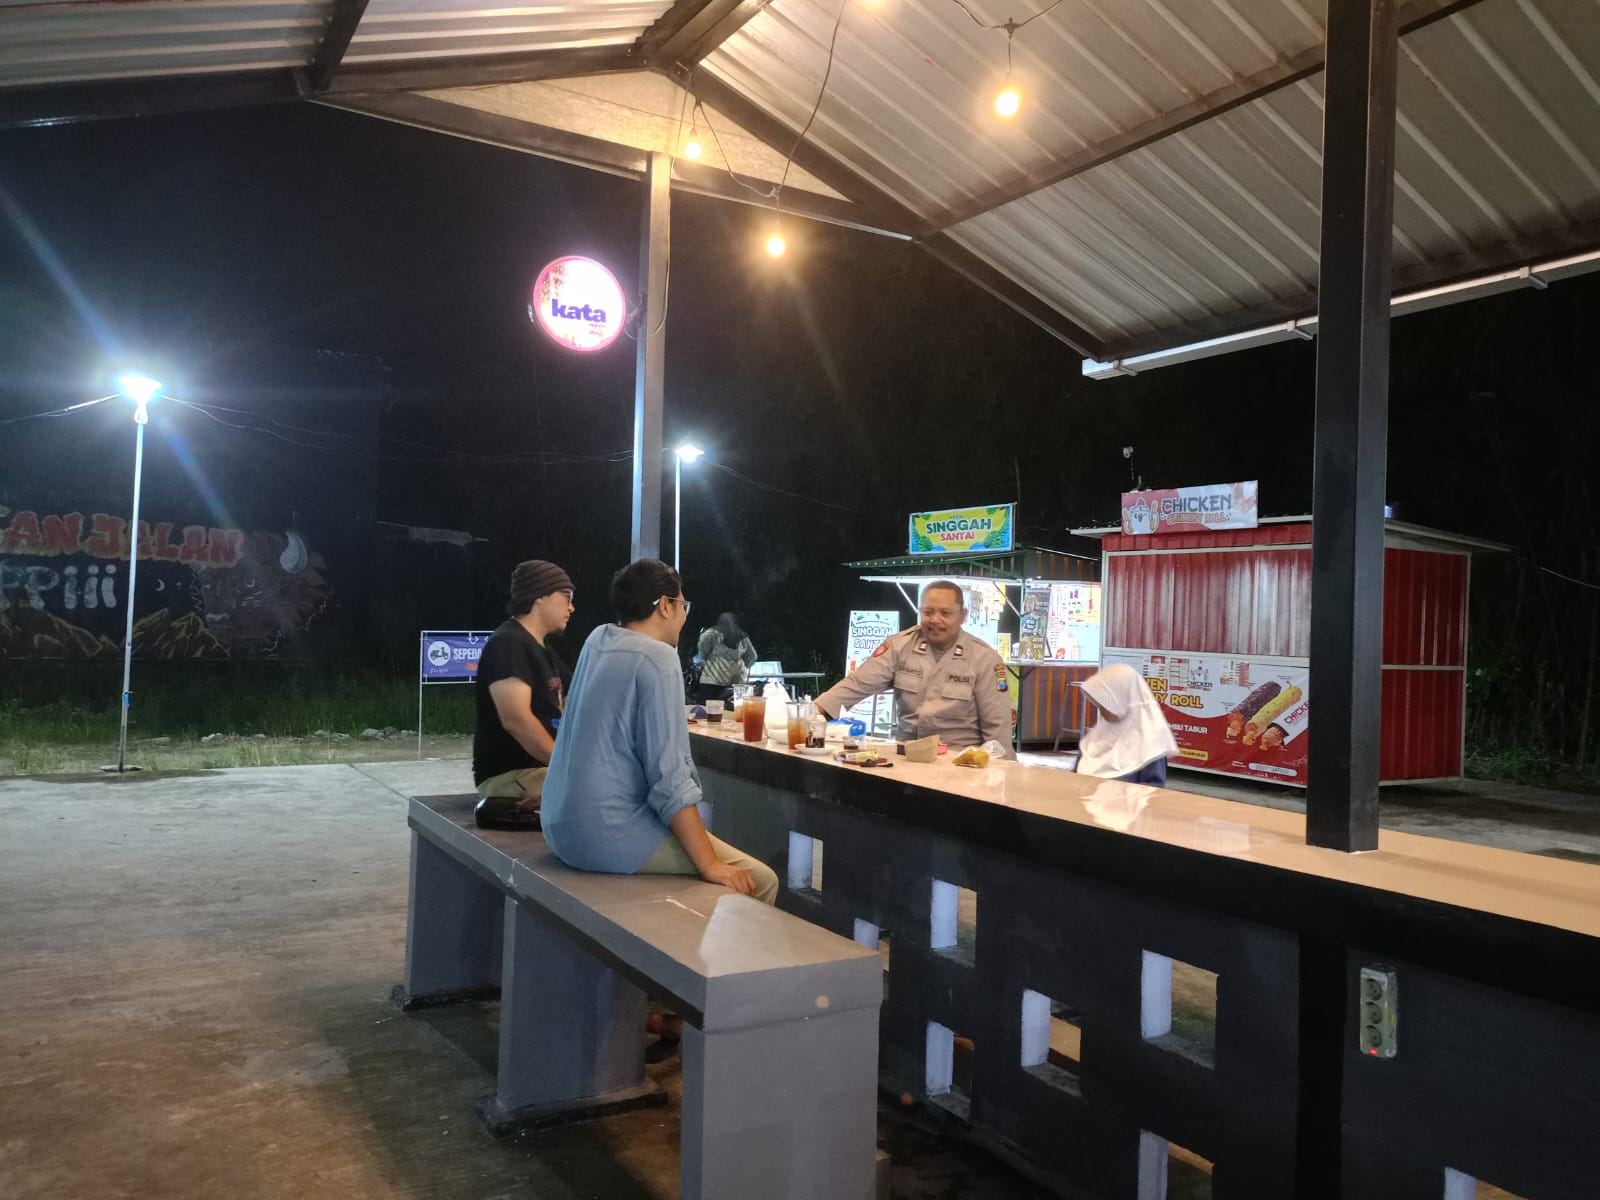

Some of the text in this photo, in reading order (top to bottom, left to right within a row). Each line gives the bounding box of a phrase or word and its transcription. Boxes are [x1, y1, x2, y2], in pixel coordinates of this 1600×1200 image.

[551, 298, 606, 323] kata
[1162, 494, 1232, 515] CHICKEN
[926, 518, 992, 534] SINGGAH
[940, 531, 975, 541] SANTAI
[851, 626, 893, 638] SINGGAH
[1186, 680, 1213, 688] CHICKEN
[1170, 693, 1204, 709] ROLL
[1184, 724, 1209, 735] TABUR
